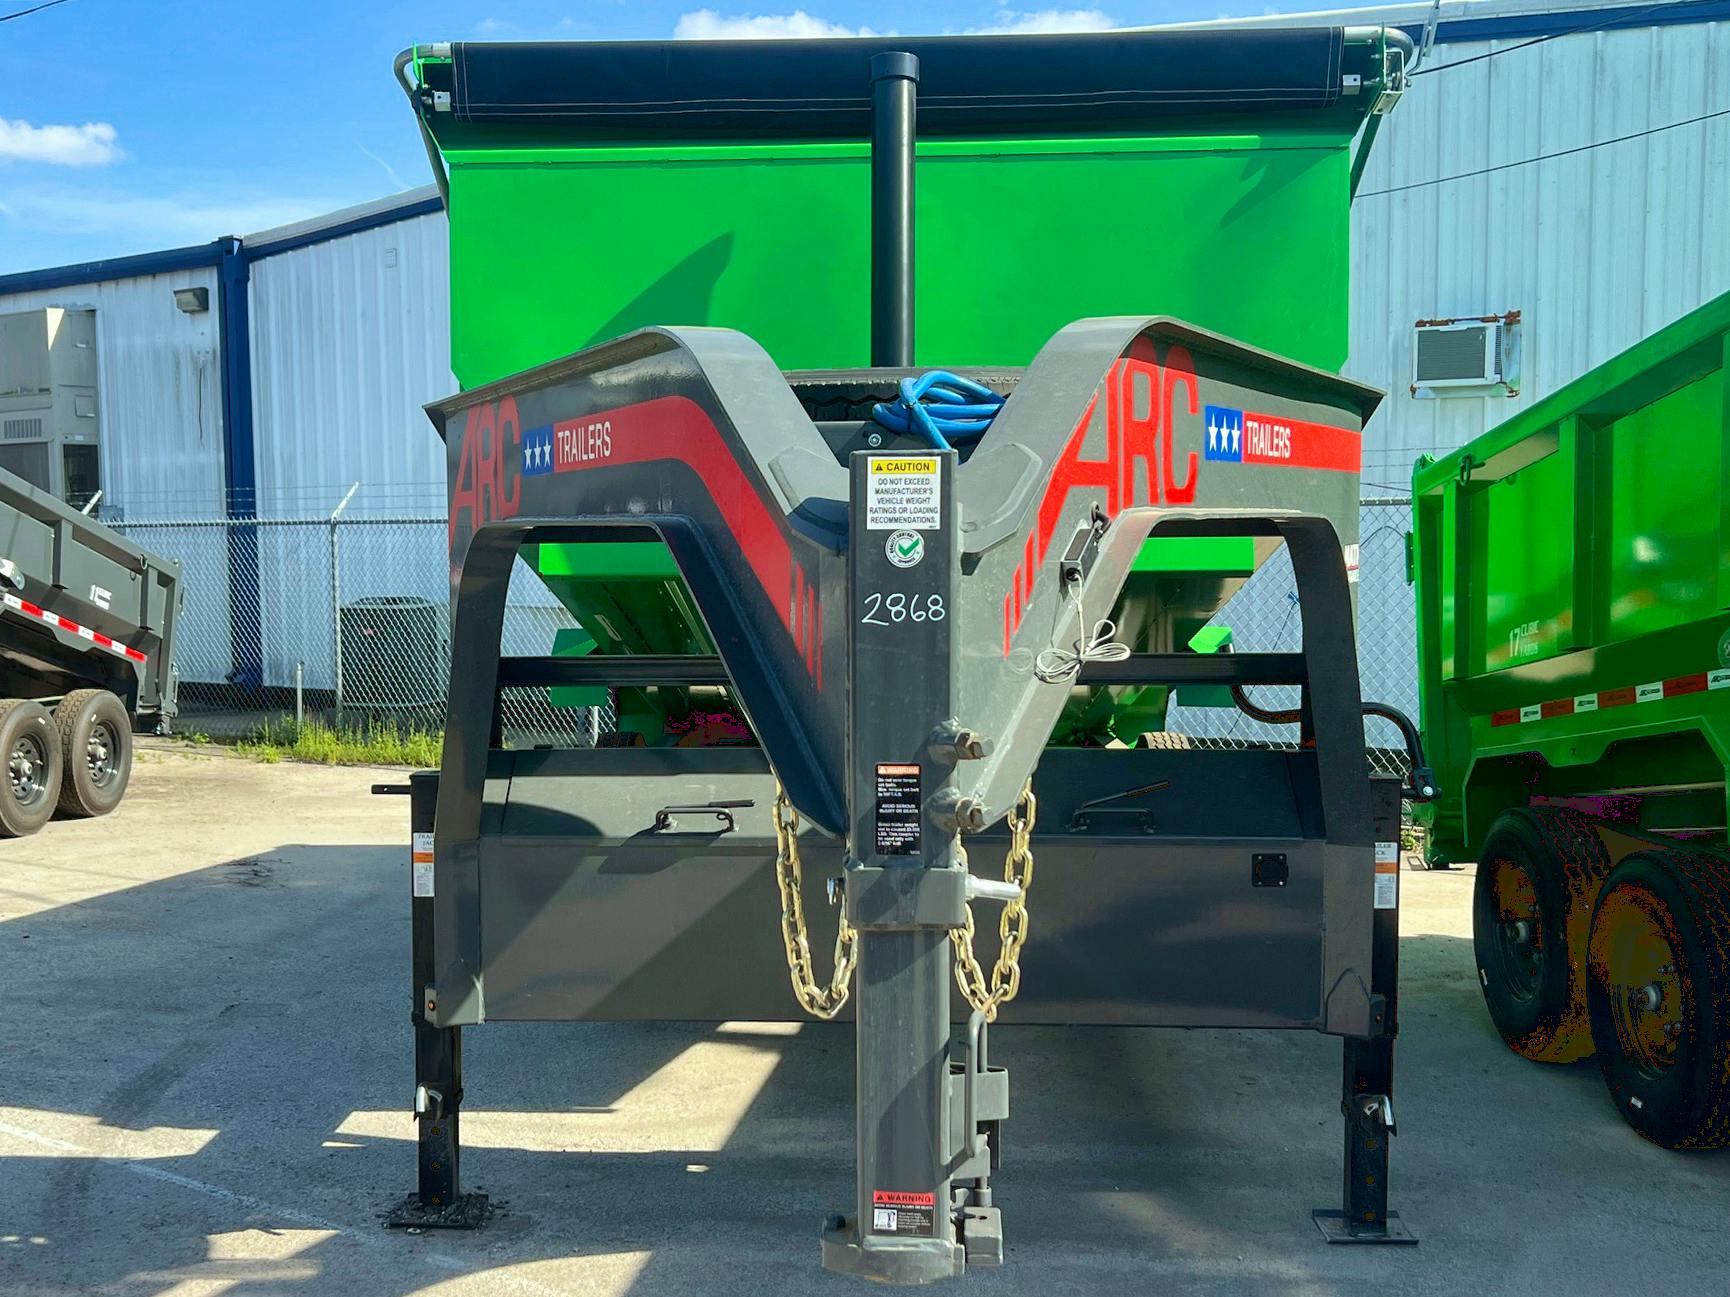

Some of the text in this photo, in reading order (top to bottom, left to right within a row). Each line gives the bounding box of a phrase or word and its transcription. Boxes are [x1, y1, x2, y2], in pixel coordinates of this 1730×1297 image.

[557, 421, 612, 465] TRAILERS
[1245, 420, 1292, 459] TRAILERS
[1038, 336, 1198, 571] ARC
[886, 462, 930, 472] CAUTION
[448, 394, 522, 553] ARC
[877, 478, 930, 486] DO NOT EXCEED
[874, 487, 934, 496] MANUFACTURER'S
[876, 497, 931, 505] VEHICLE WEIGHT
[869, 506, 939, 515] RATINGS OR LOADING
[870, 516, 937, 524] RECOMMENDATIONS.
[861, 592, 946, 626] 2868
[1509, 627, 1521, 657] 17
[887, 1193, 932, 1203] WARNING
